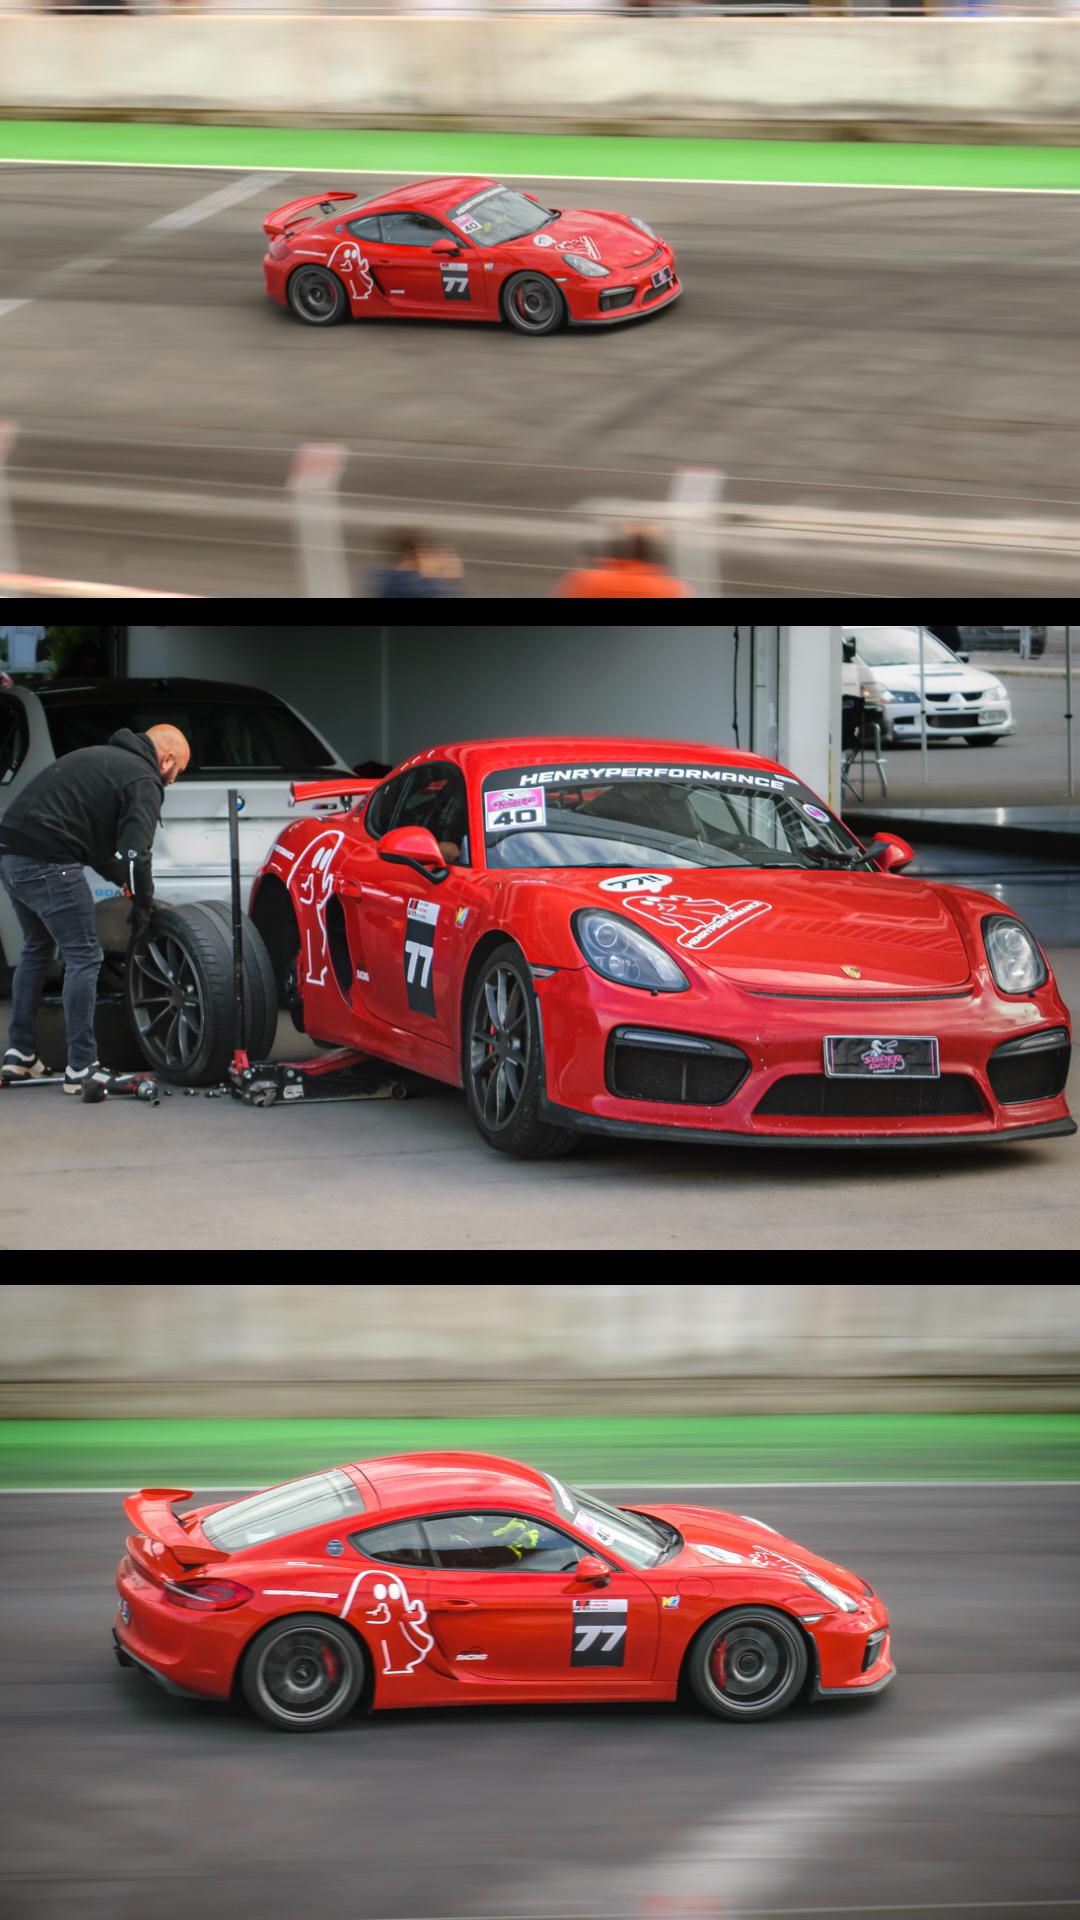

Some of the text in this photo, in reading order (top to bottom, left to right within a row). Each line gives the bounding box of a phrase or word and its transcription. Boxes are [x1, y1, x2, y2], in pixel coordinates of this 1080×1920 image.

[465, 222, 478, 233] 40
[443, 277, 469, 293] 77
[519, 767, 785, 792] HENRYPERFORMANCE
[493, 809, 537, 826] 40
[685, 901, 763, 949] HENRYPERFORMANCE
[405, 940, 434, 989] 77
[863, 1054, 903, 1065] SUPER
[869, 1062, 898, 1070] DRIFT
[574, 1625, 628, 1652] 77
